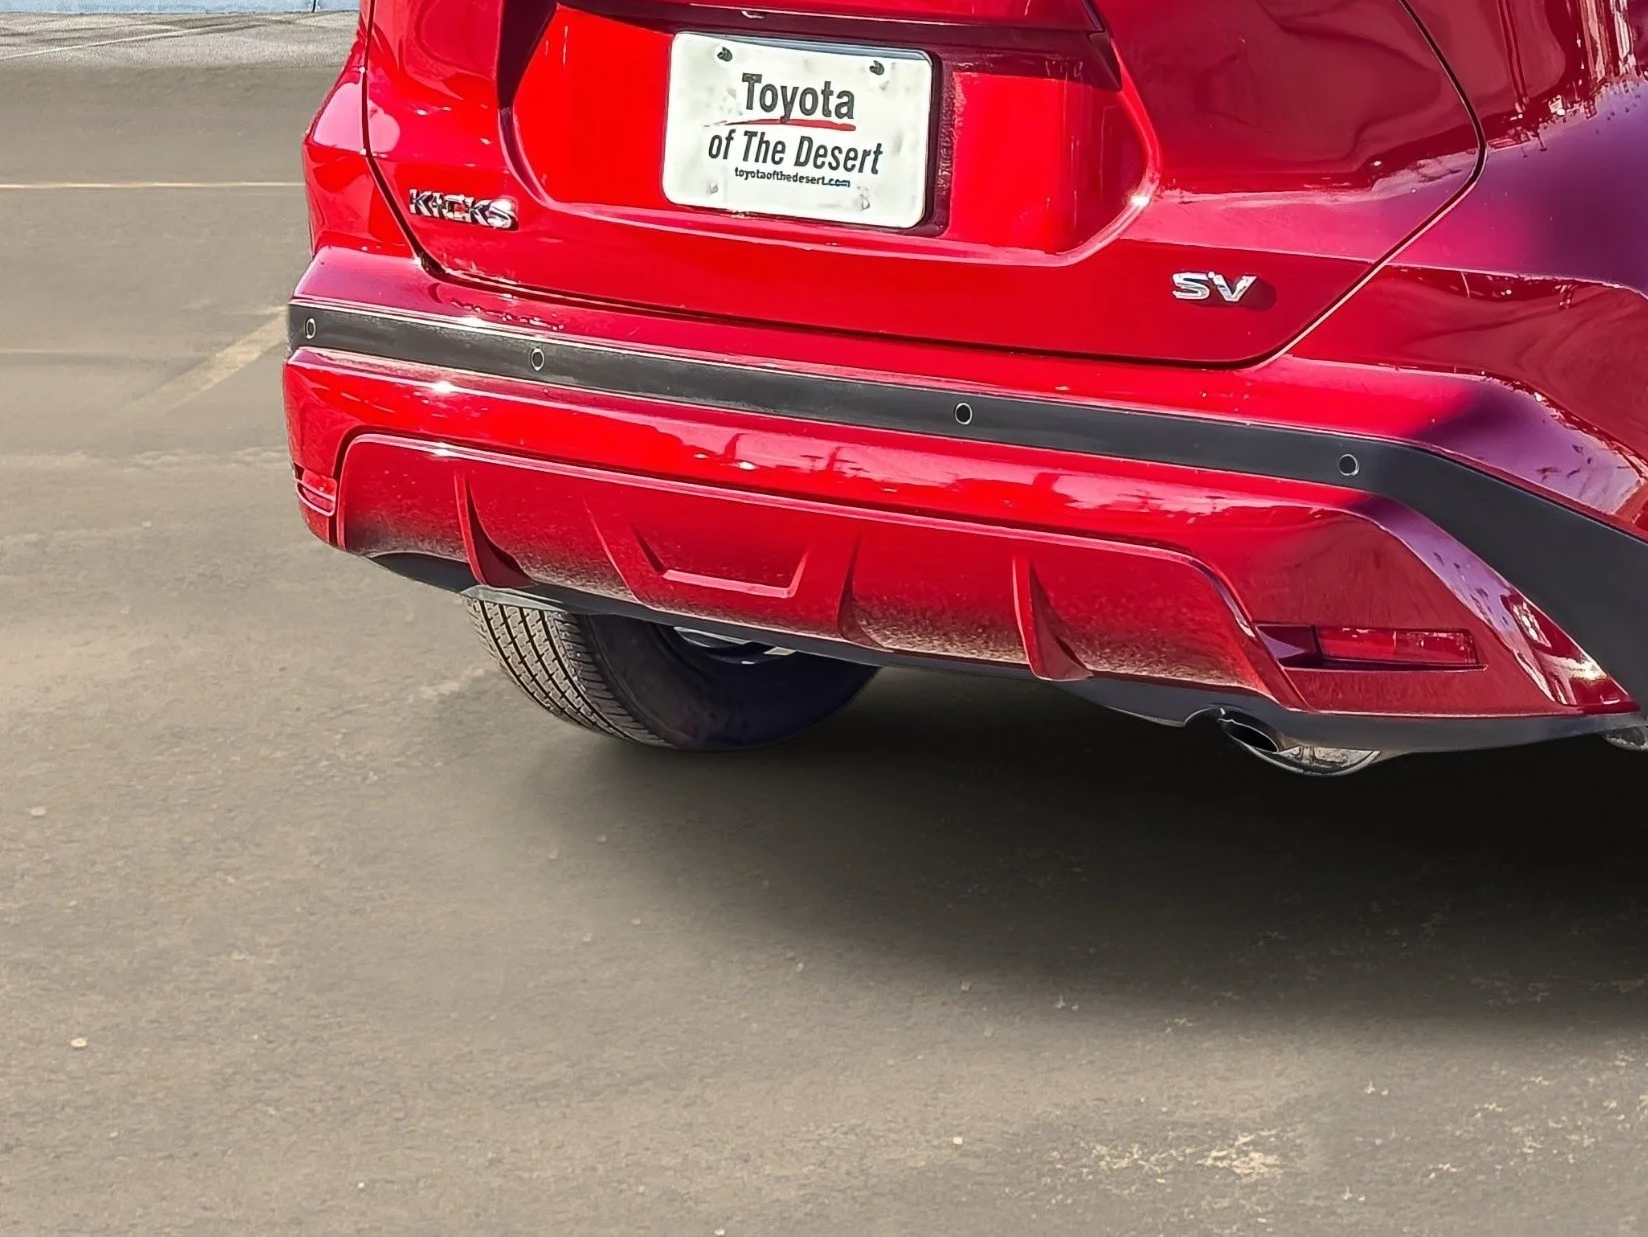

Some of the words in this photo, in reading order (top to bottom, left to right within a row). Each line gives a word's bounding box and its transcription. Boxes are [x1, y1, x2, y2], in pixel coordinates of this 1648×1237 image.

[741, 72, 856, 124] Toyota
[707, 128, 737, 160] of
[741, 130, 787, 166] The
[793, 135, 884, 175] Desert
[734, 166, 851, 188] toyotaofthedesert.com
[408, 188, 514, 229] KICKS
[1171, 270, 1258, 303] SV
